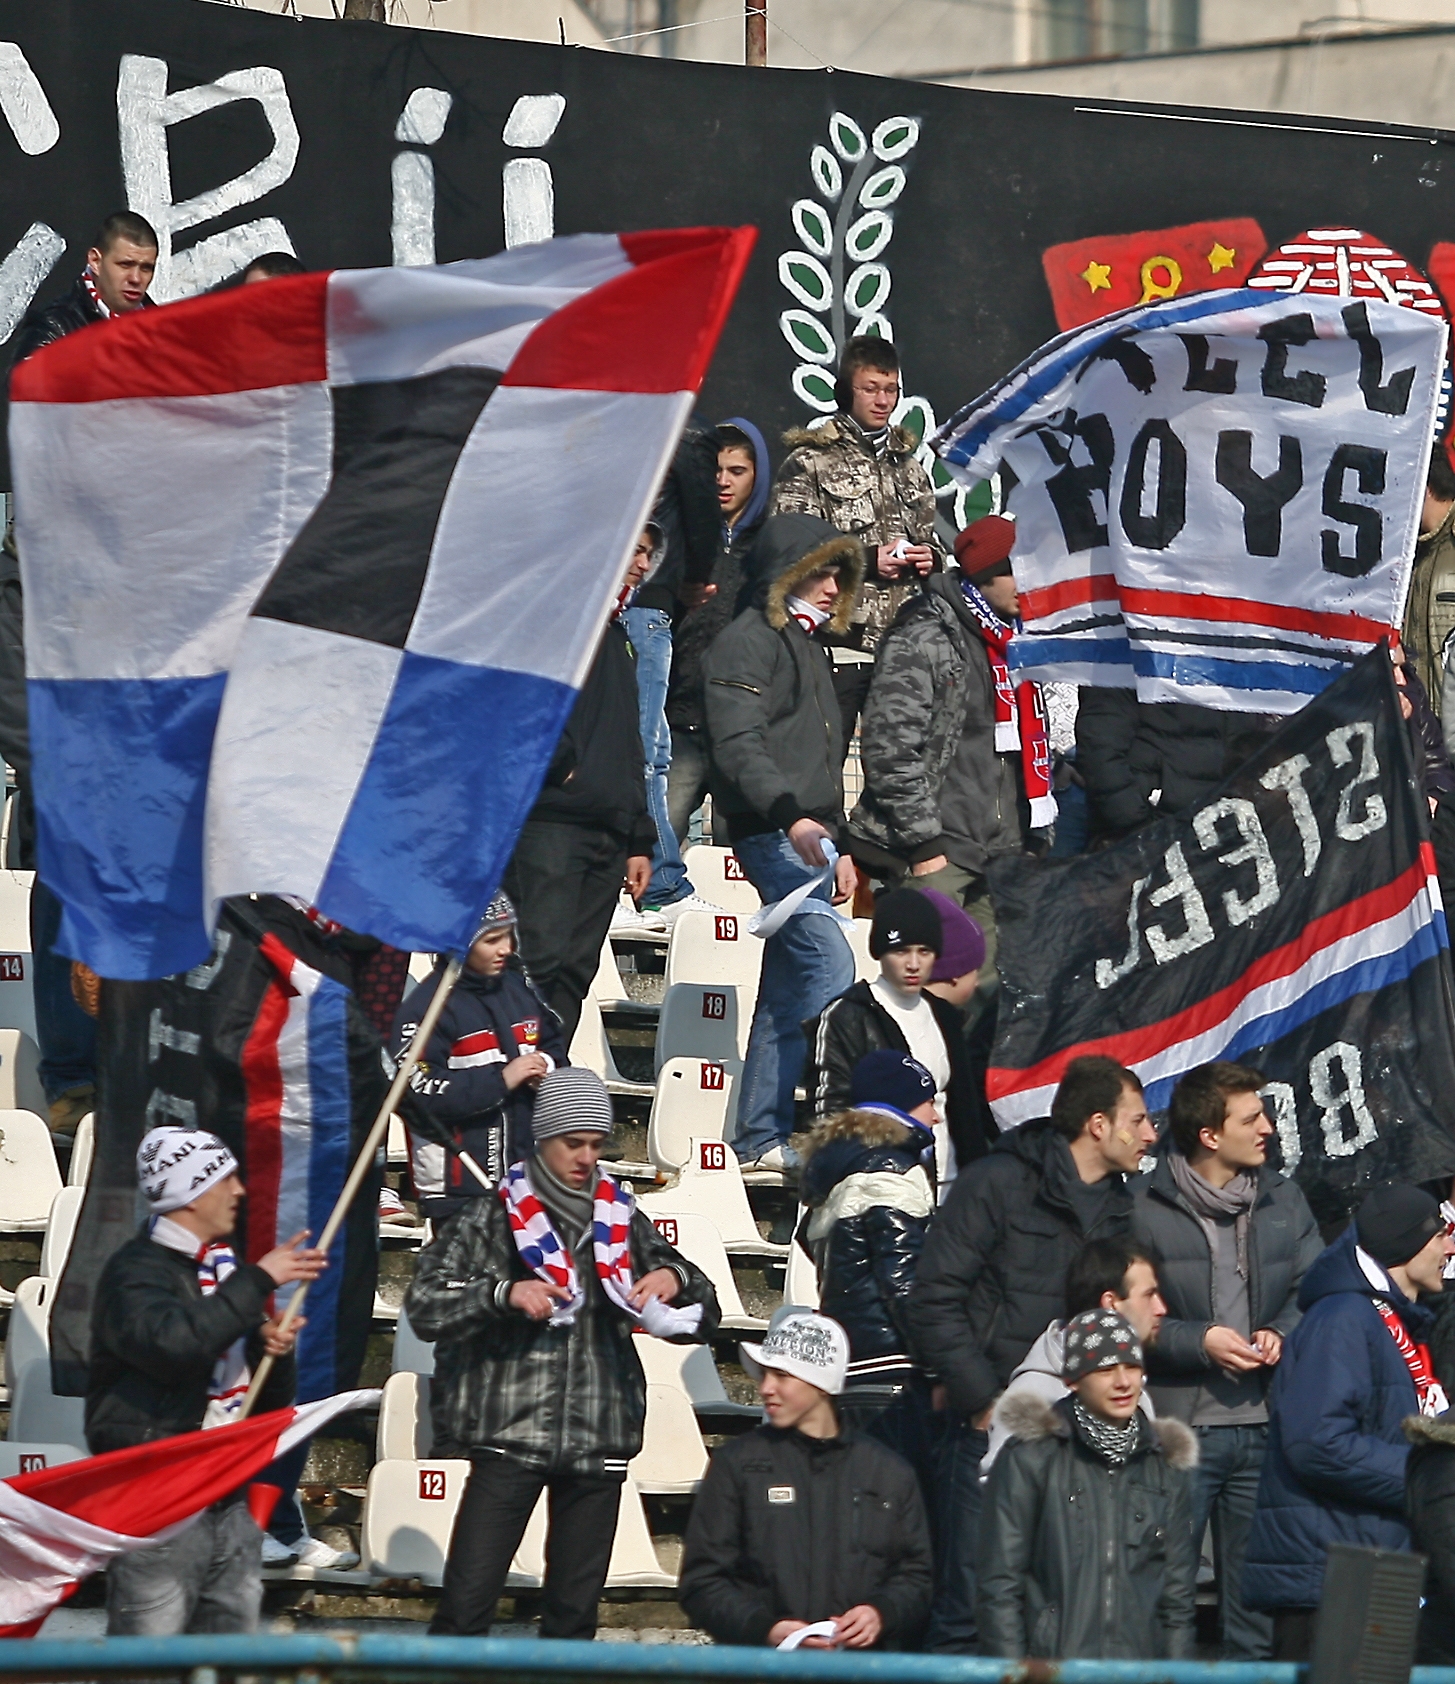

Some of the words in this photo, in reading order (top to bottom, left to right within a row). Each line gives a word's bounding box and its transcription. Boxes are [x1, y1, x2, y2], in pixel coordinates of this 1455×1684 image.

[1014, 405, 1388, 578] BOYS
[718, 918, 736, 938] 19
[2, 957, 21, 978] 14
[706, 993, 723, 1016] 18
[704, 1065, 722, 1087] 17
[704, 1145, 723, 1168] 16
[657, 1221, 676, 1244] 15
[421, 1471, 445, 1499] 12
